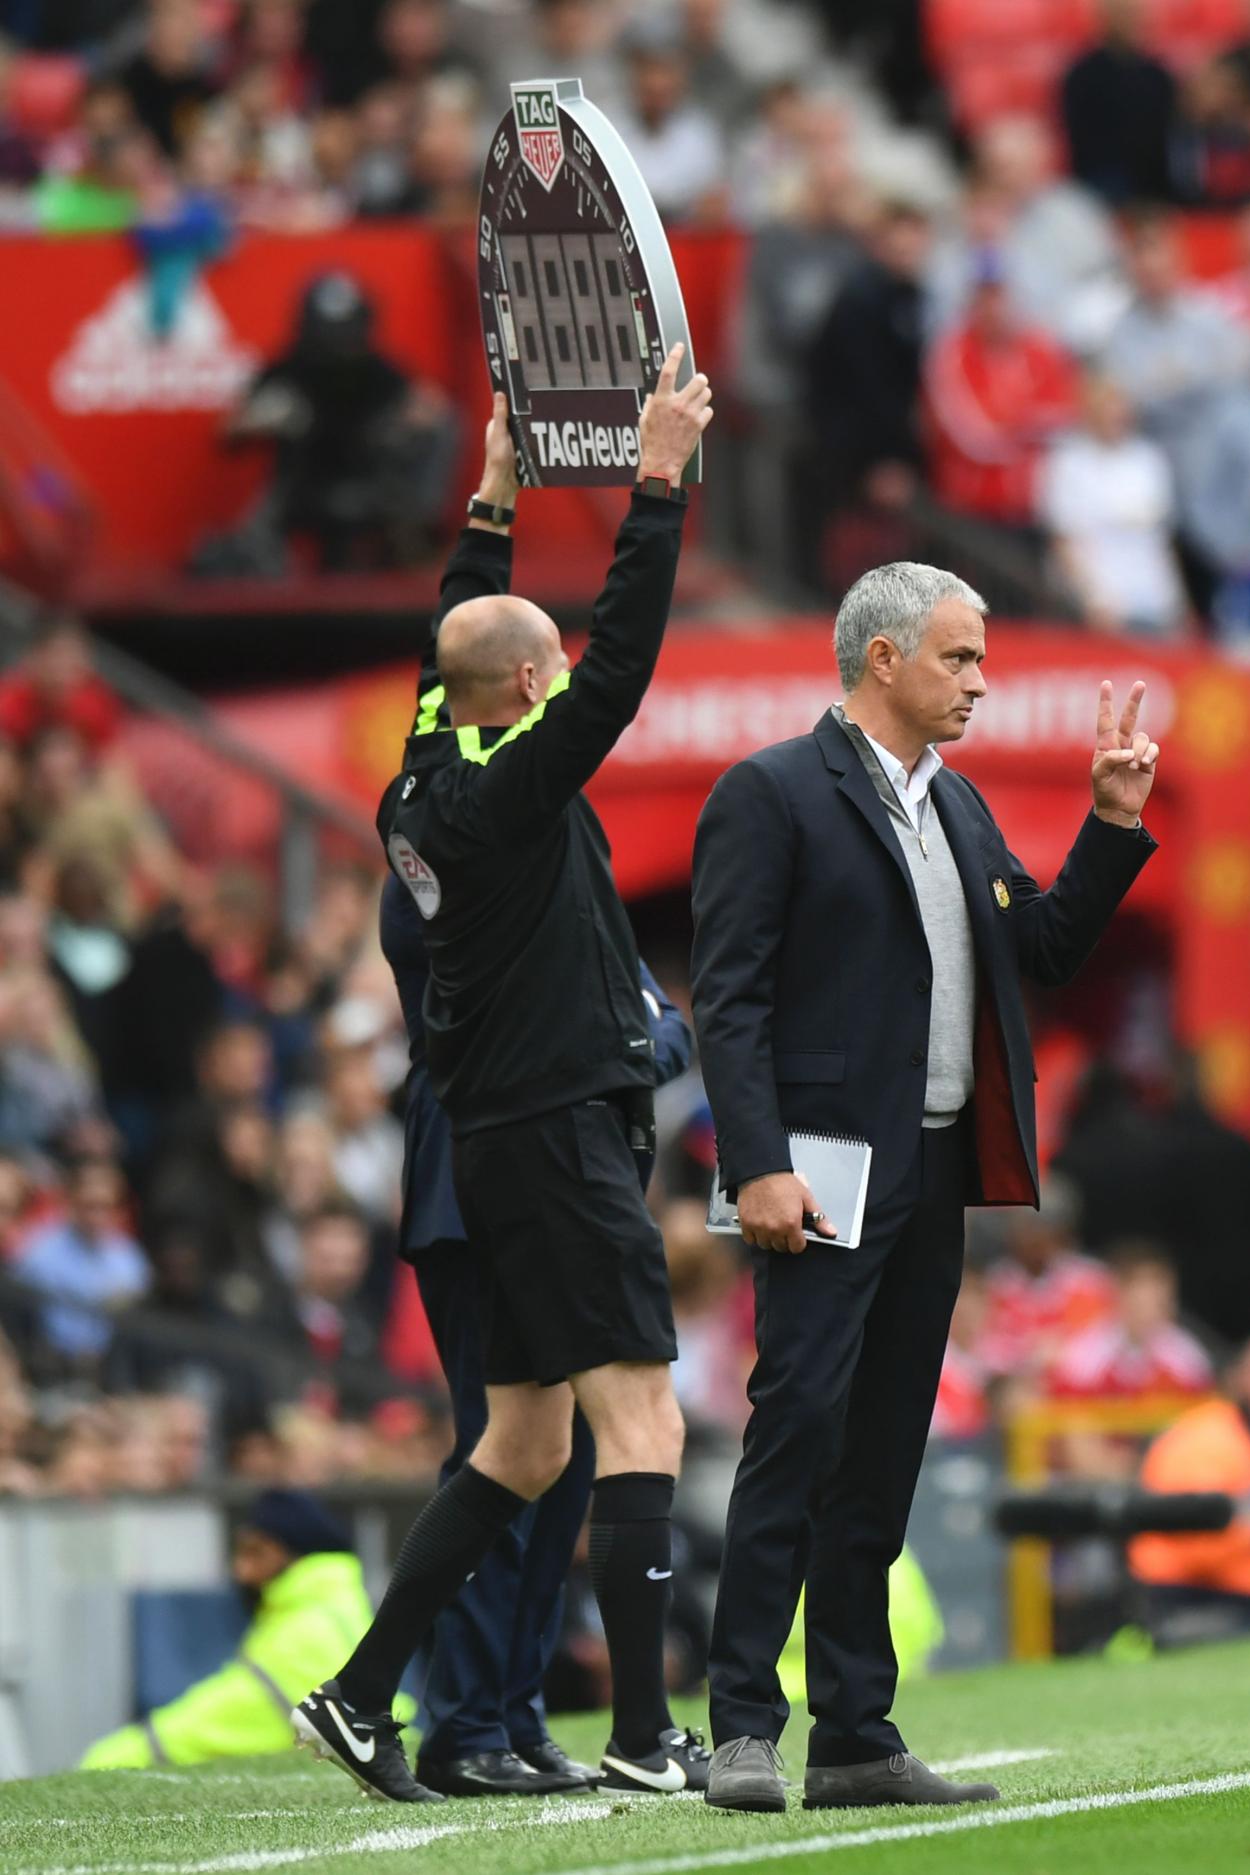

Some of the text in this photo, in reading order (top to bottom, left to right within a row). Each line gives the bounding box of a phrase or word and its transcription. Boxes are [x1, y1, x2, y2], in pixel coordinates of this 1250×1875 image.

[516, 93, 555, 125] TAG
[493, 131, 510, 170] 55
[521, 132, 563, 181] HEUER
[572, 129, 592, 167] 05
[619, 215, 635, 254] 10
[398, 849, 432, 880] EA
